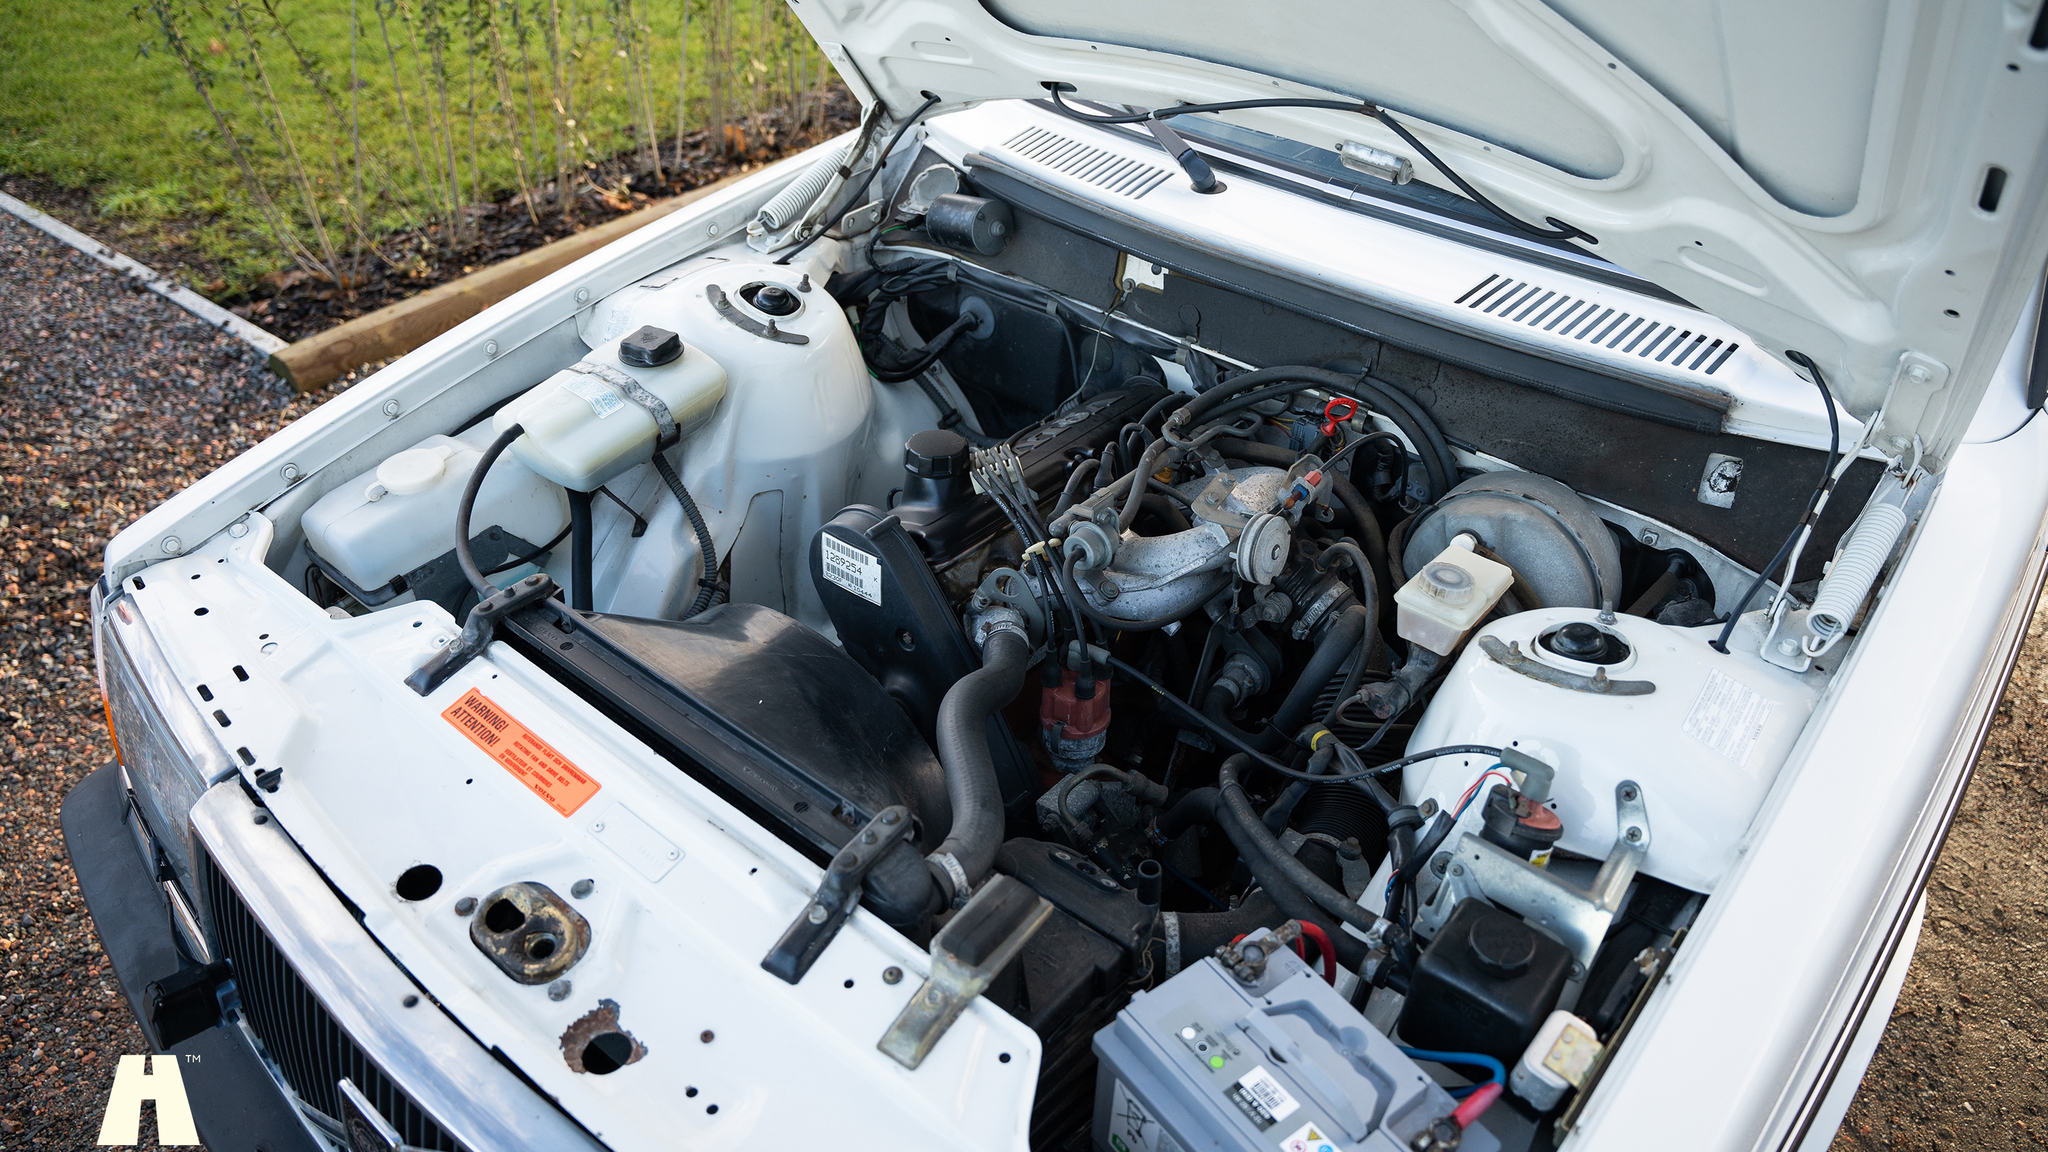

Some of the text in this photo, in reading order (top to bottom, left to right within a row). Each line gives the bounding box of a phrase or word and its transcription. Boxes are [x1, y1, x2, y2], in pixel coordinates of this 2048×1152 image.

[1011, 395, 1126, 457] VOLV
[995, 497, 1010, 514] VOLVO
[825, 549, 863, 576] 1289254
[449, 705, 501, 747] ATTENTION!
[463, 695, 510, 732] WARNING!
[1752, 724, 1762, 741] VOLVO
[503, 757, 527, 777] MOUVEMENT
[503, 748, 528, 768] VENTILATEUR
[530, 769, 553, 788] COURROIES
[512, 740, 570, 787] ROTATING FAN AND DRIVE BELTS
[521, 732, 587, 784] ROTERANDE FLÄKT OCH DRIVREMMAR
[1381, 763, 1401, 773] VOLVO
[533, 783, 555, 802] VOLVO
[1225, 788, 1274, 850] WEST-GERMANY
